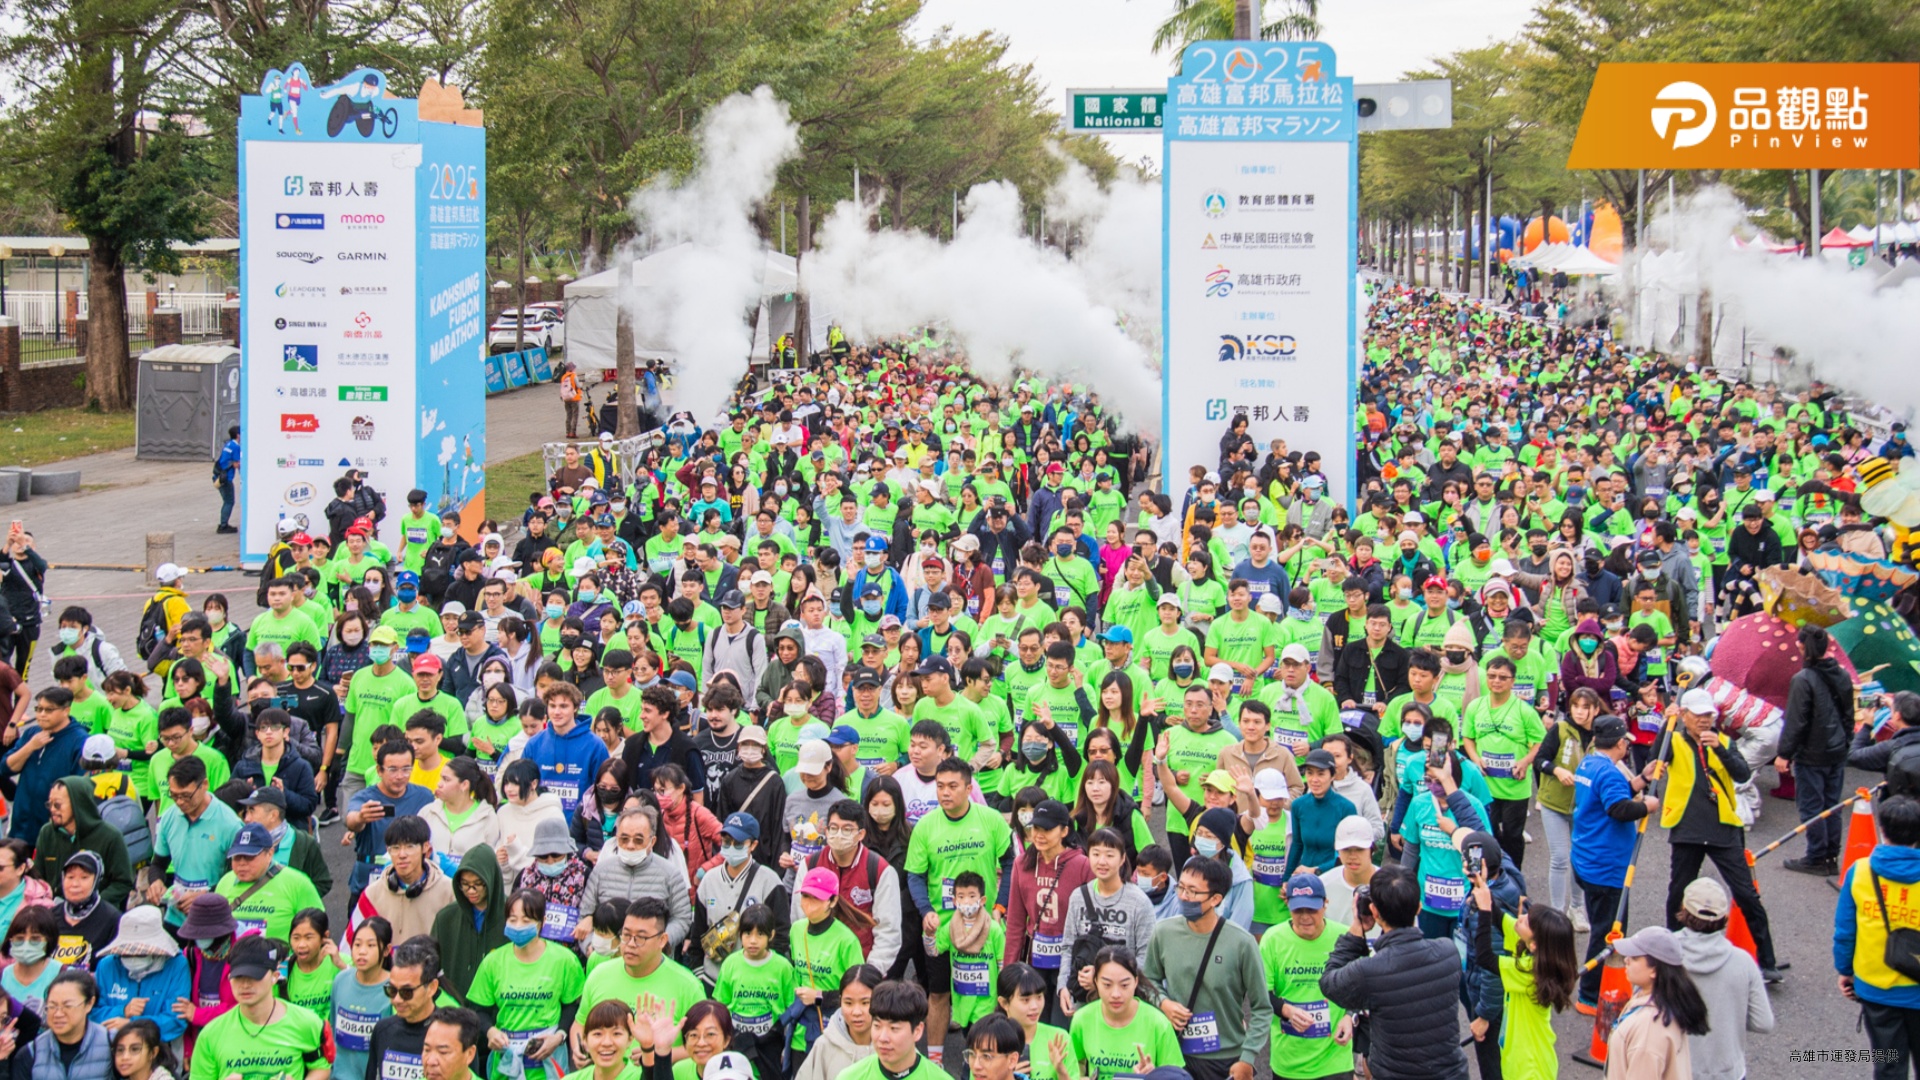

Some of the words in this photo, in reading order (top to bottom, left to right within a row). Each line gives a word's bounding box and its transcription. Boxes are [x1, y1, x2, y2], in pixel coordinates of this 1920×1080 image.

[1192, 47, 1327, 83] 2025
[1177, 83, 1343, 106] 高雄富邦馬拉松
[1084, 97, 1157, 113] 國家體
[1084, 116, 1146, 127] National
[1178, 115, 1341, 136] 高雄富邦マラソン
[1241, 165, 1276, 174] 指導單位
[429, 163, 478, 200] 2025
[309, 181, 378, 197] 富邦人壽
[1238, 194, 1315, 206] 教育部體育署
[340, 214, 385, 224] momo
[430, 205, 479, 223] 高雄富邦馬拉松
[1220, 232, 1314, 244] 中華民國田徑協會
[276, 251, 314, 259] saucony
[337, 252, 387, 260] GARMIN
[1237, 273, 1302, 286] 高雄市政府
[430, 272, 479, 318] KAOHSIUNG
[449, 293, 480, 329] FUBON
[430, 315, 480, 365] MARATHON
[1246, 334, 1297, 355] KSD
[1175, 750, 1216, 760] KAOHSIUNG
[937, 840, 985, 854] KAOHSIUNG
[1256, 863, 1285, 873] 50982
[1428, 884, 1458, 896] 51081
[1036, 887, 1059, 924] 9
[954, 970, 983, 982] 51654
[340, 1019, 373, 1034] 50840
[226, 1056, 293, 1069] KAOHSIUNG
[719, 1055, 733, 1071] A
